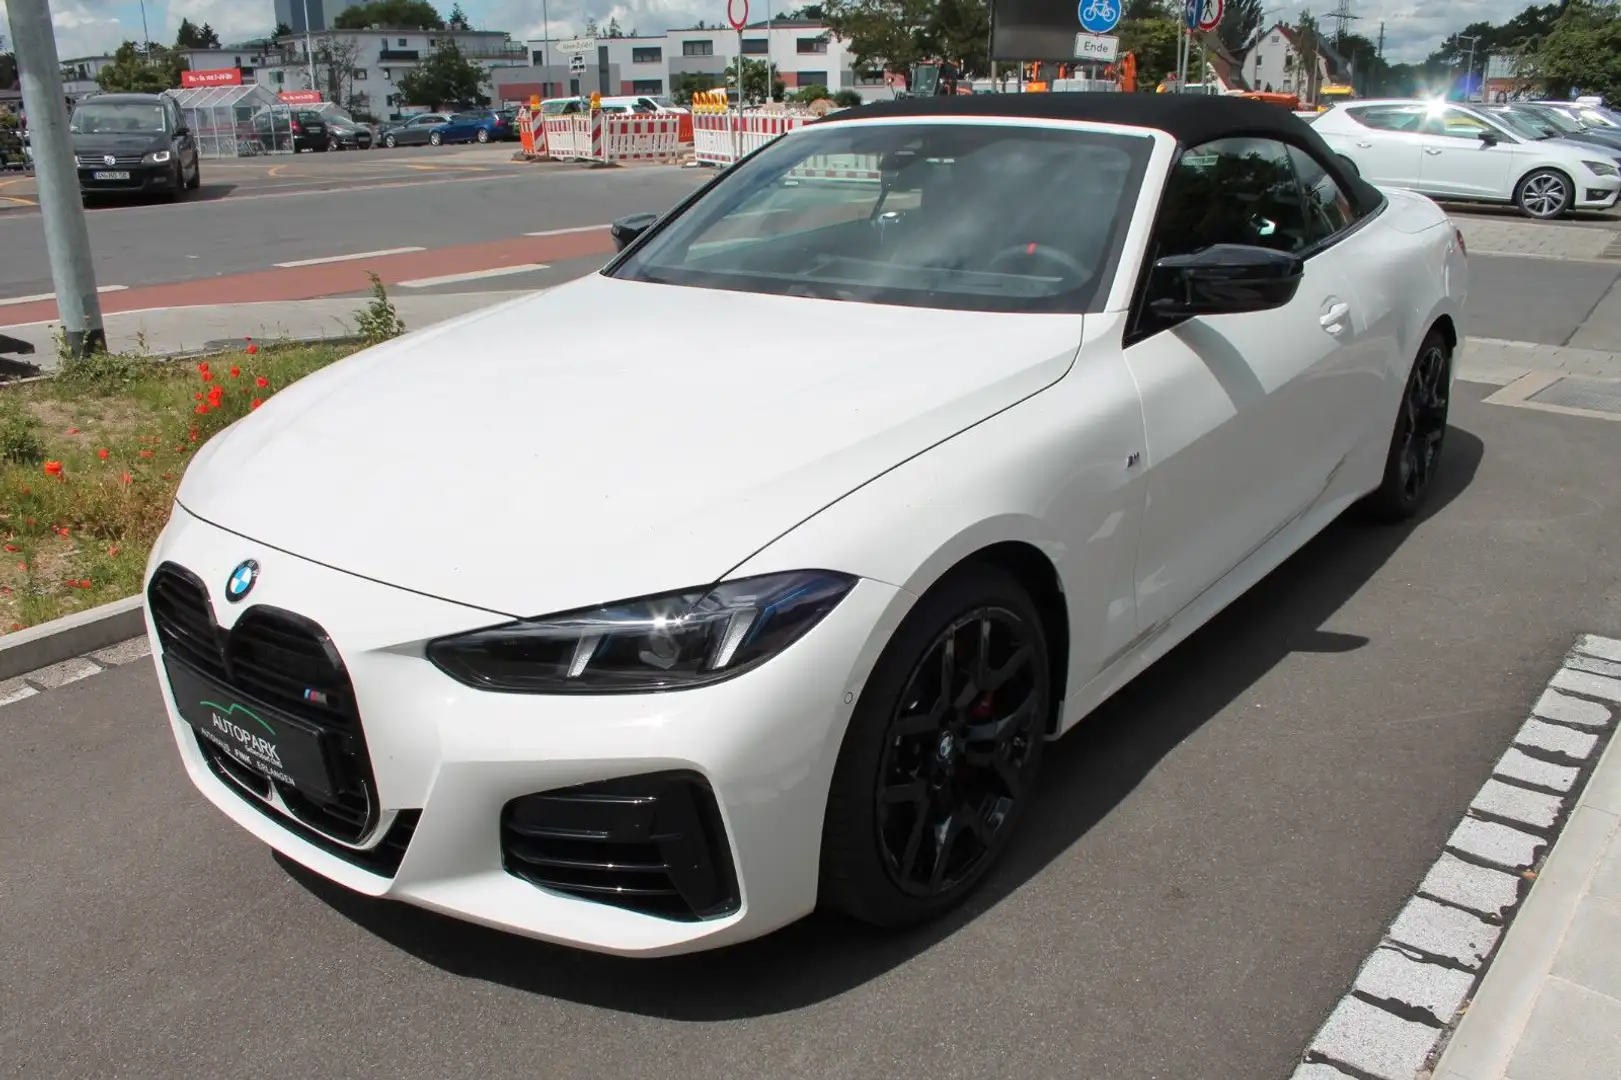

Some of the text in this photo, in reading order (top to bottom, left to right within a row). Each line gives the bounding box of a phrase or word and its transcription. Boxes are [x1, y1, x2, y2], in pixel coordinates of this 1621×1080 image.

[1084, 41, 1109, 53] Ende
[212, 711, 281, 761] AUTOPARK
[256, 760, 296, 787] ERLANGEN
